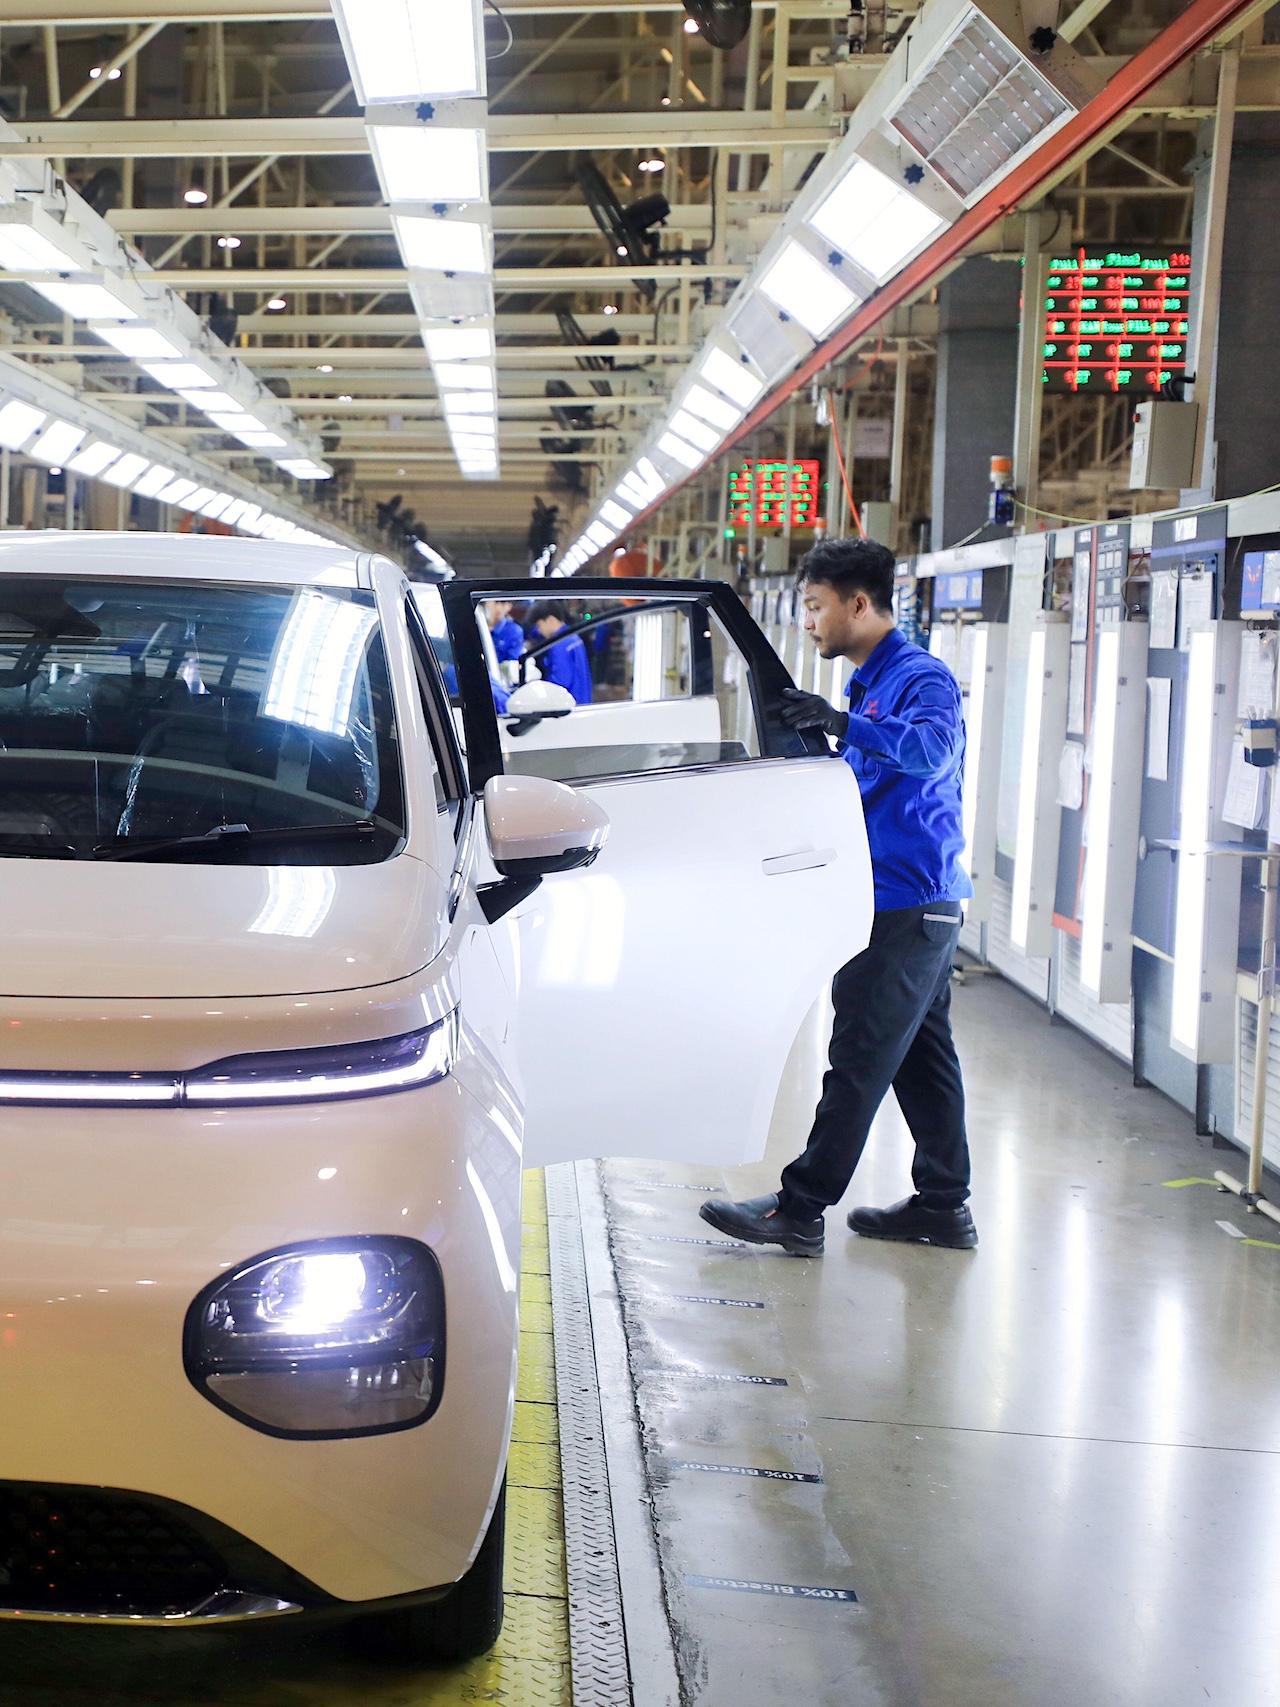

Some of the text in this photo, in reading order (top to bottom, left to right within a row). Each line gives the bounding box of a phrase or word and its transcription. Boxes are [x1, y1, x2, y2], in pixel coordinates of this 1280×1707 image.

[736, 1375, 773, 1384] 10%
[680, 1463, 805, 1481] 10% Bisector
[705, 1578, 848, 1599] 10% Bisector
